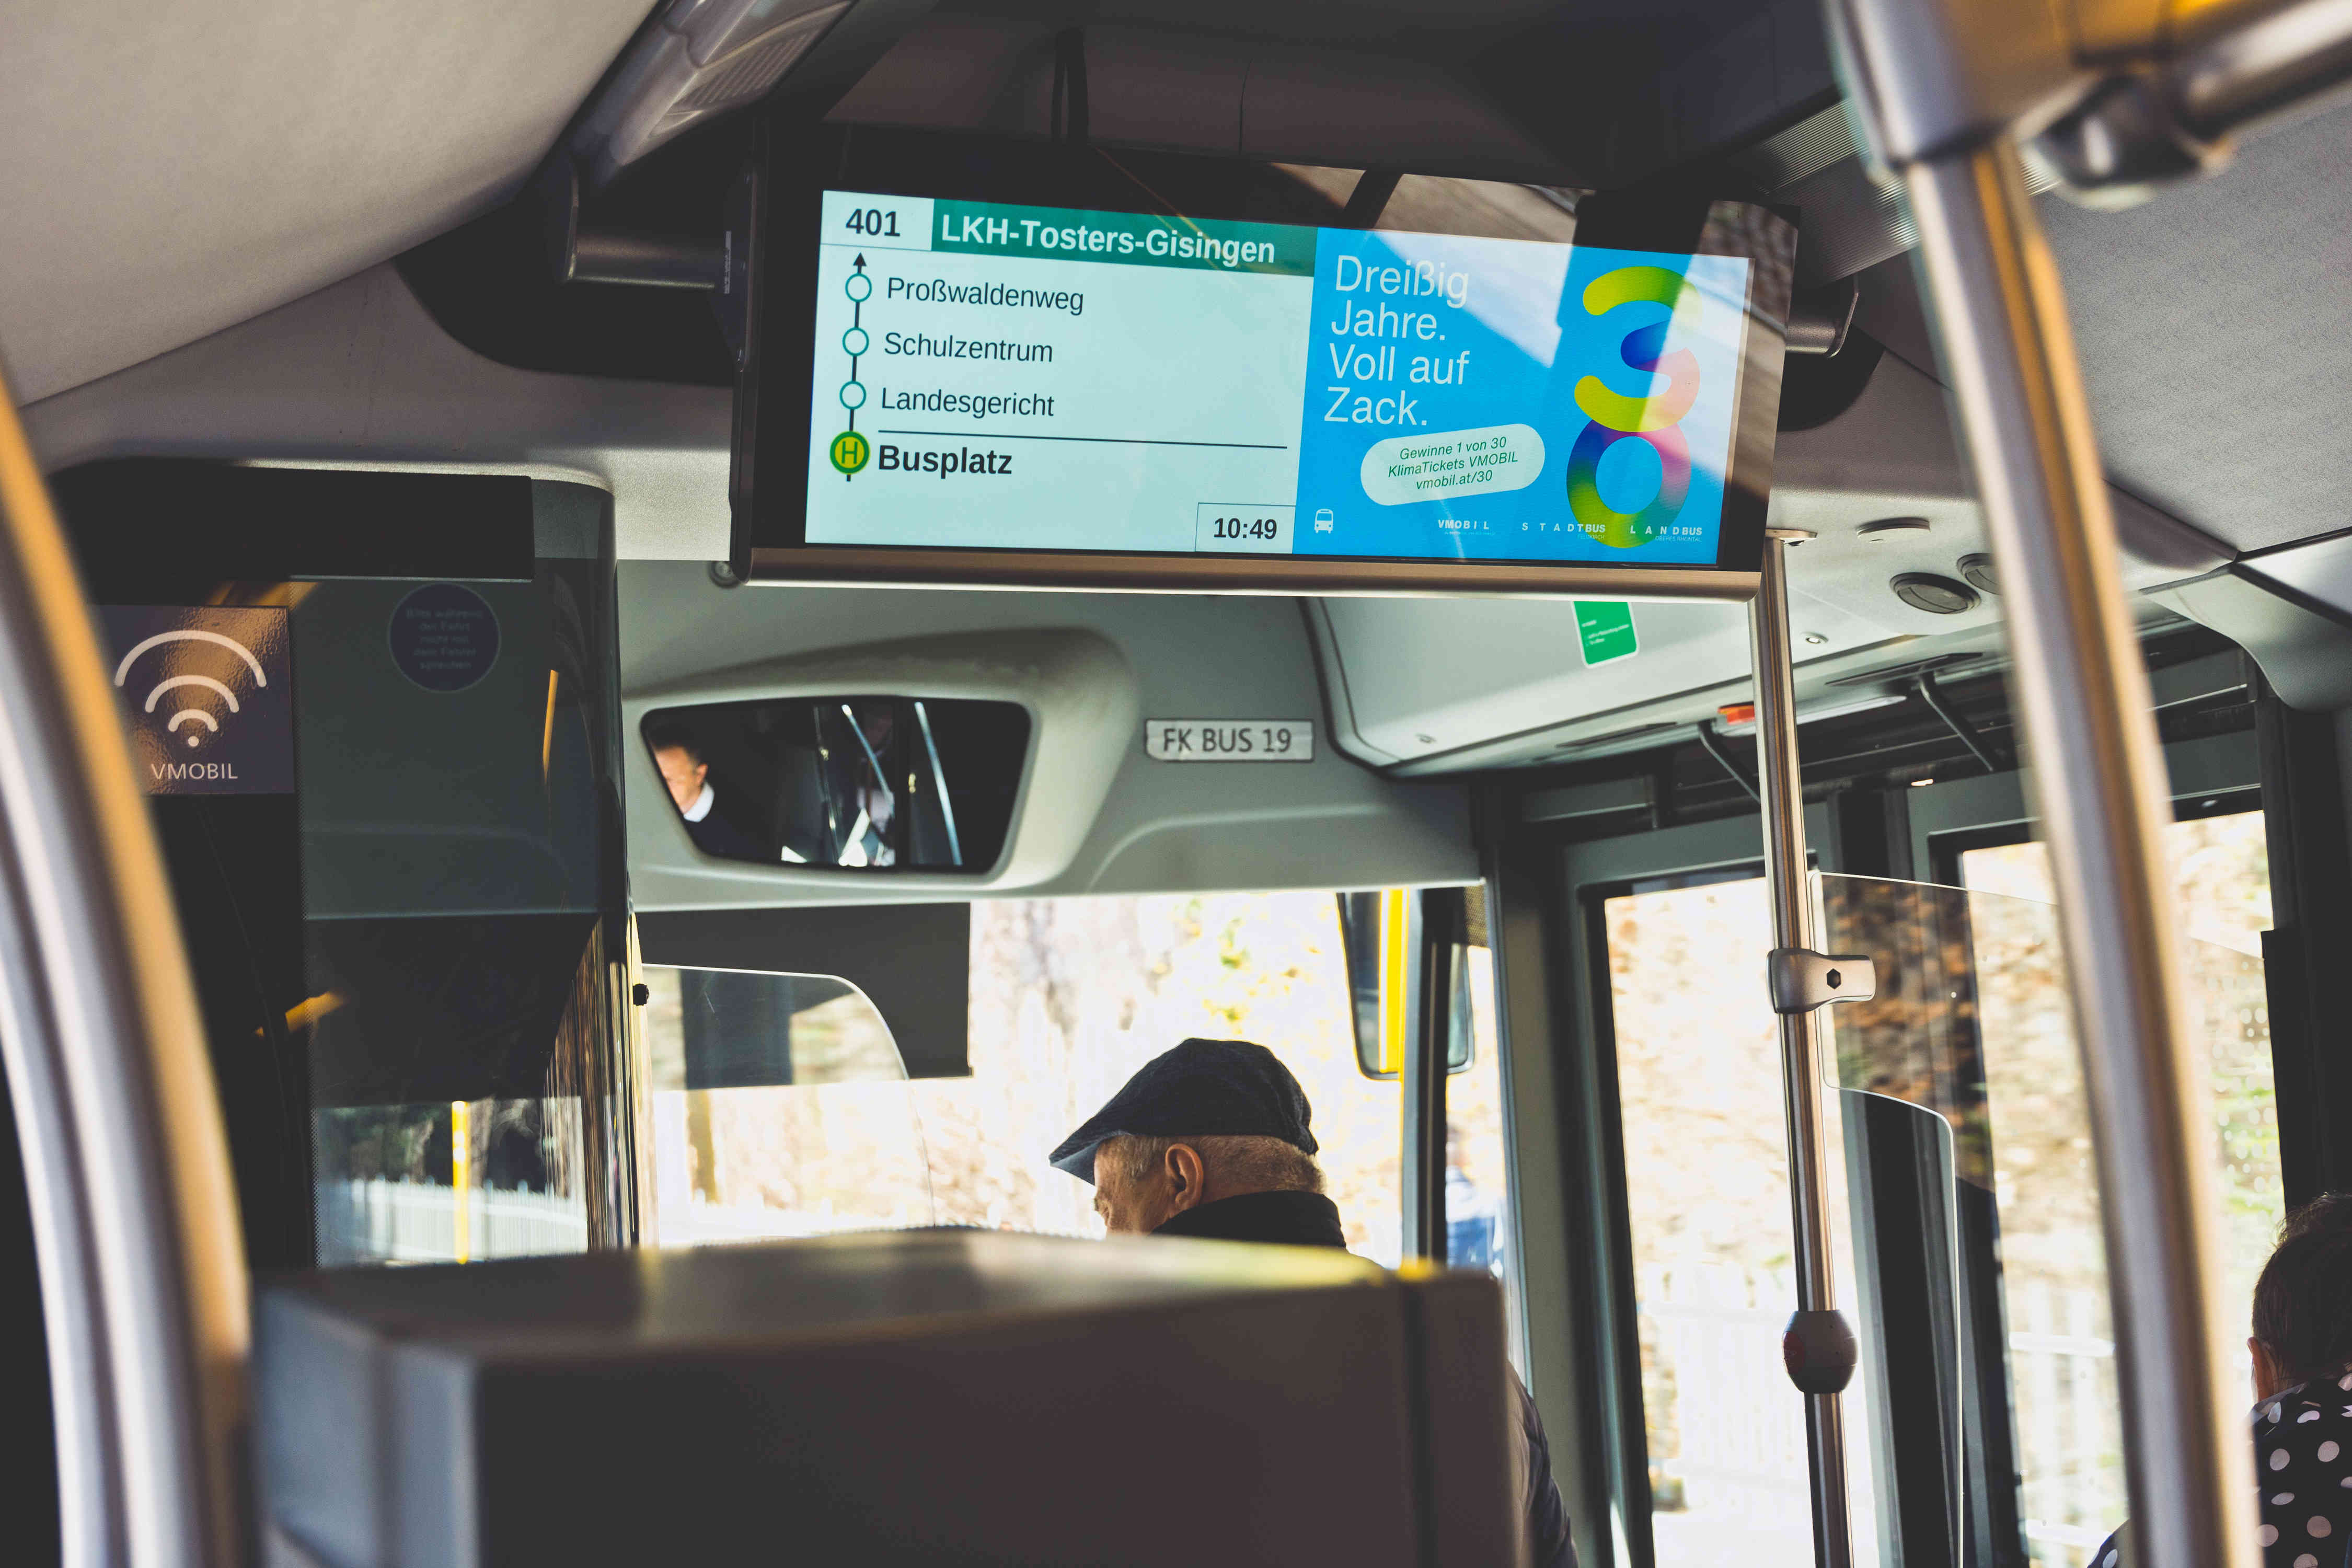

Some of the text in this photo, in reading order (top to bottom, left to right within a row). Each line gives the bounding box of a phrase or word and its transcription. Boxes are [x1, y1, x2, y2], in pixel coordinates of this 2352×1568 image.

[845, 208, 901, 237] 401
[940, 213, 1276, 267] LKH-Tosters-Gisingen
[1335, 255, 1469, 308] Dreißig
[887, 276, 1084, 316] Proßwaldenweg
[1331, 299, 1446, 341] Jahre.
[884, 332, 1053, 363] Schulzentrum
[1329, 342, 1470, 385] Voll auf
[881, 387, 1055, 419] Landesgericht
[1324, 386, 1427, 426] Zack.
[841, 441, 858, 466] H
[1400, 436, 1507, 460] Gewinne 1 von 30
[878, 444, 1012, 480] Busplatz
[1388, 451, 1518, 477] KlimaTickets VMOBIL
[1416, 469, 1493, 490] vmobil.at/30
[1213, 517, 1277, 540] 10:49
[1438, 519, 1490, 530] VMOBIL
[1521, 522, 1606, 533] STADTBUS
[1630, 525, 1703, 536] LANDBUS
[1163, 727, 1292, 753] FK BUS 19
[150, 763, 238, 780] VMOBIL
